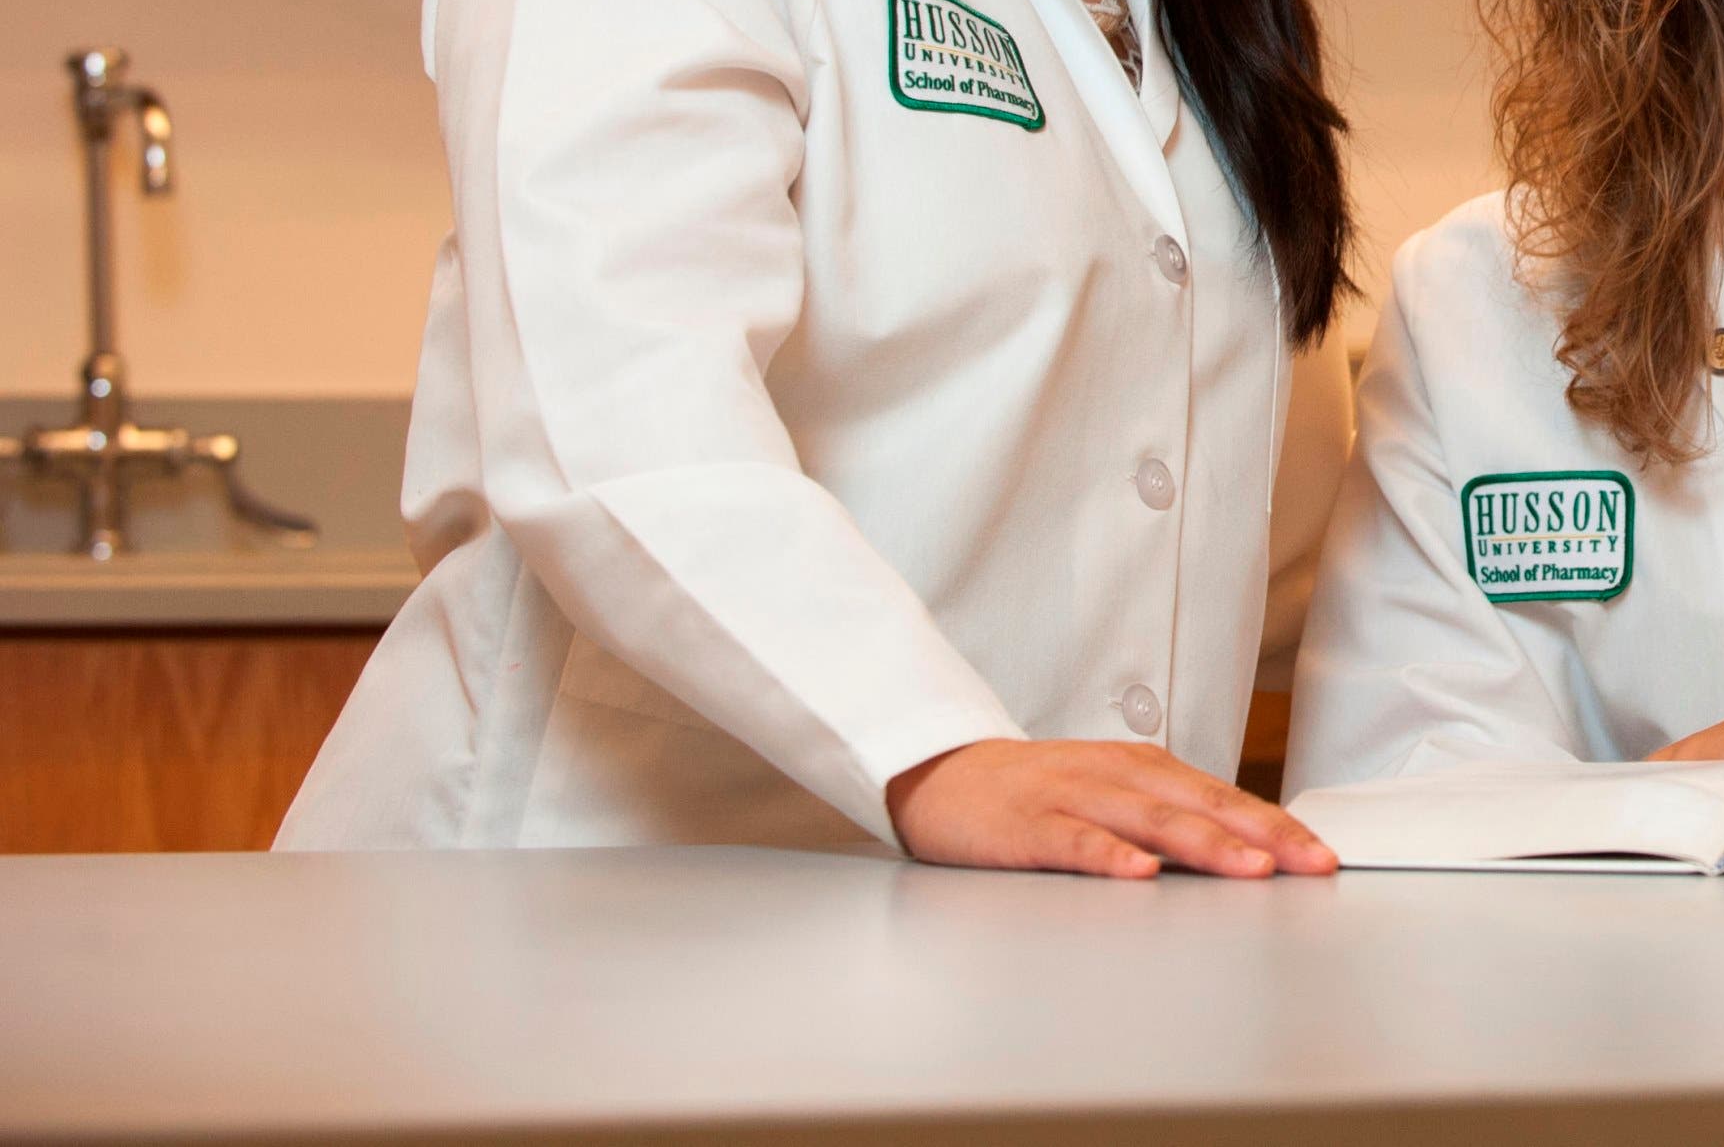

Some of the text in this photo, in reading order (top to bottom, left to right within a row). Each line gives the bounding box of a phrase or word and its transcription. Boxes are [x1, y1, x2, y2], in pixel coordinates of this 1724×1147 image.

[904, 43, 1026, 90] UNIVERSITY
[904, 70, 1037, 117] School of Pharmacy
[1474, 490, 1620, 535] HUSSON
[1478, 535, 1618, 557] UNIVERSITY
[1481, 564, 1618, 584] School of Pharmacy
